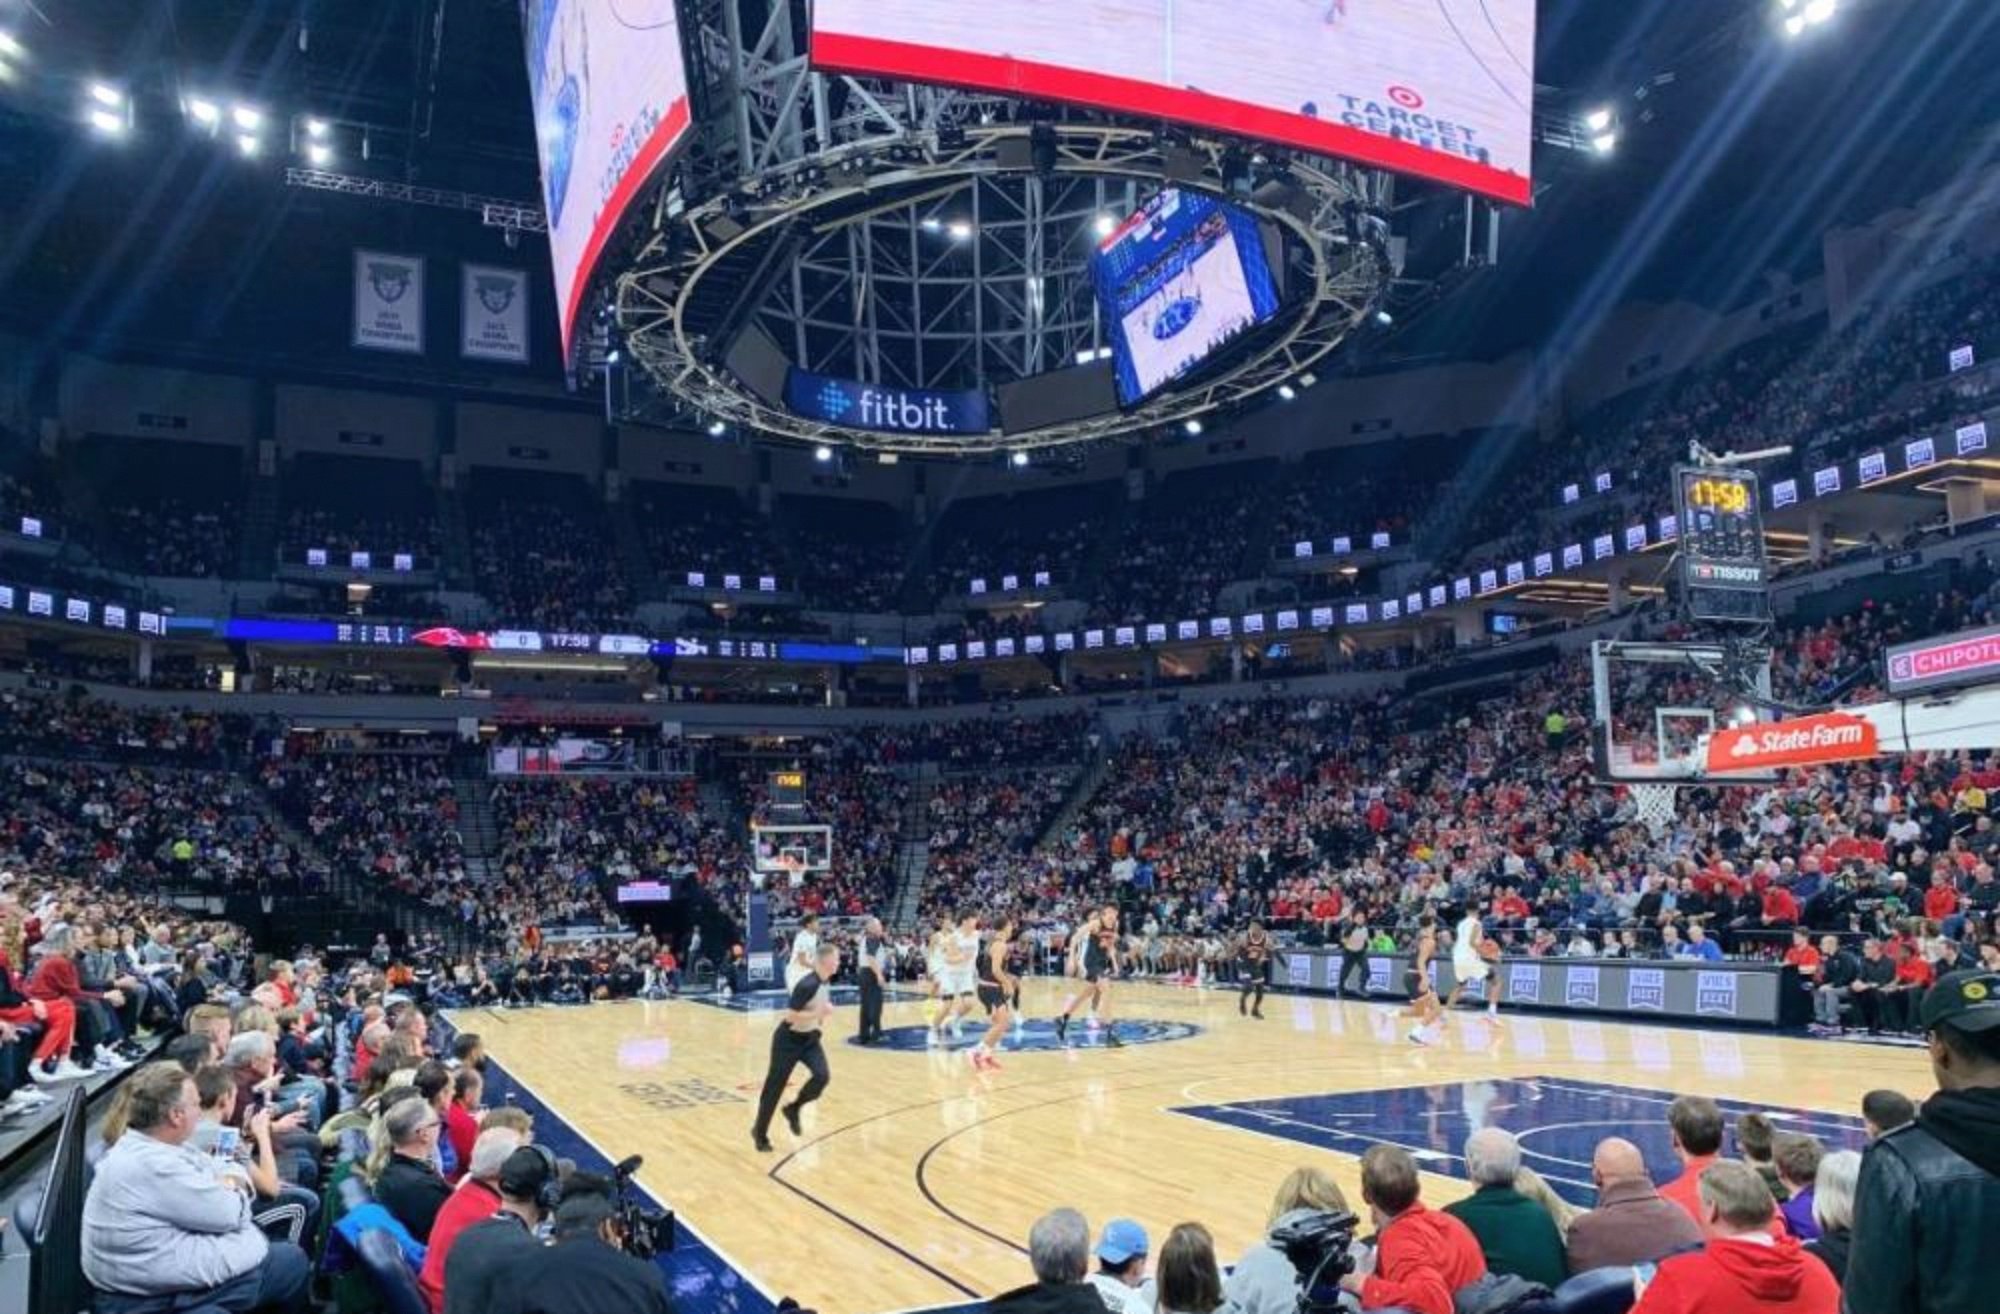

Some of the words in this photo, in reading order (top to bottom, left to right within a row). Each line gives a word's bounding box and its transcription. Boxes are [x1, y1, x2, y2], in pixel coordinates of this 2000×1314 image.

[1338, 94, 1477, 141] TARGET
[1713, 566, 1762, 582] TISSOT
[1759, 729, 1810, 752] State
[1811, 723, 1862, 746] Farm
